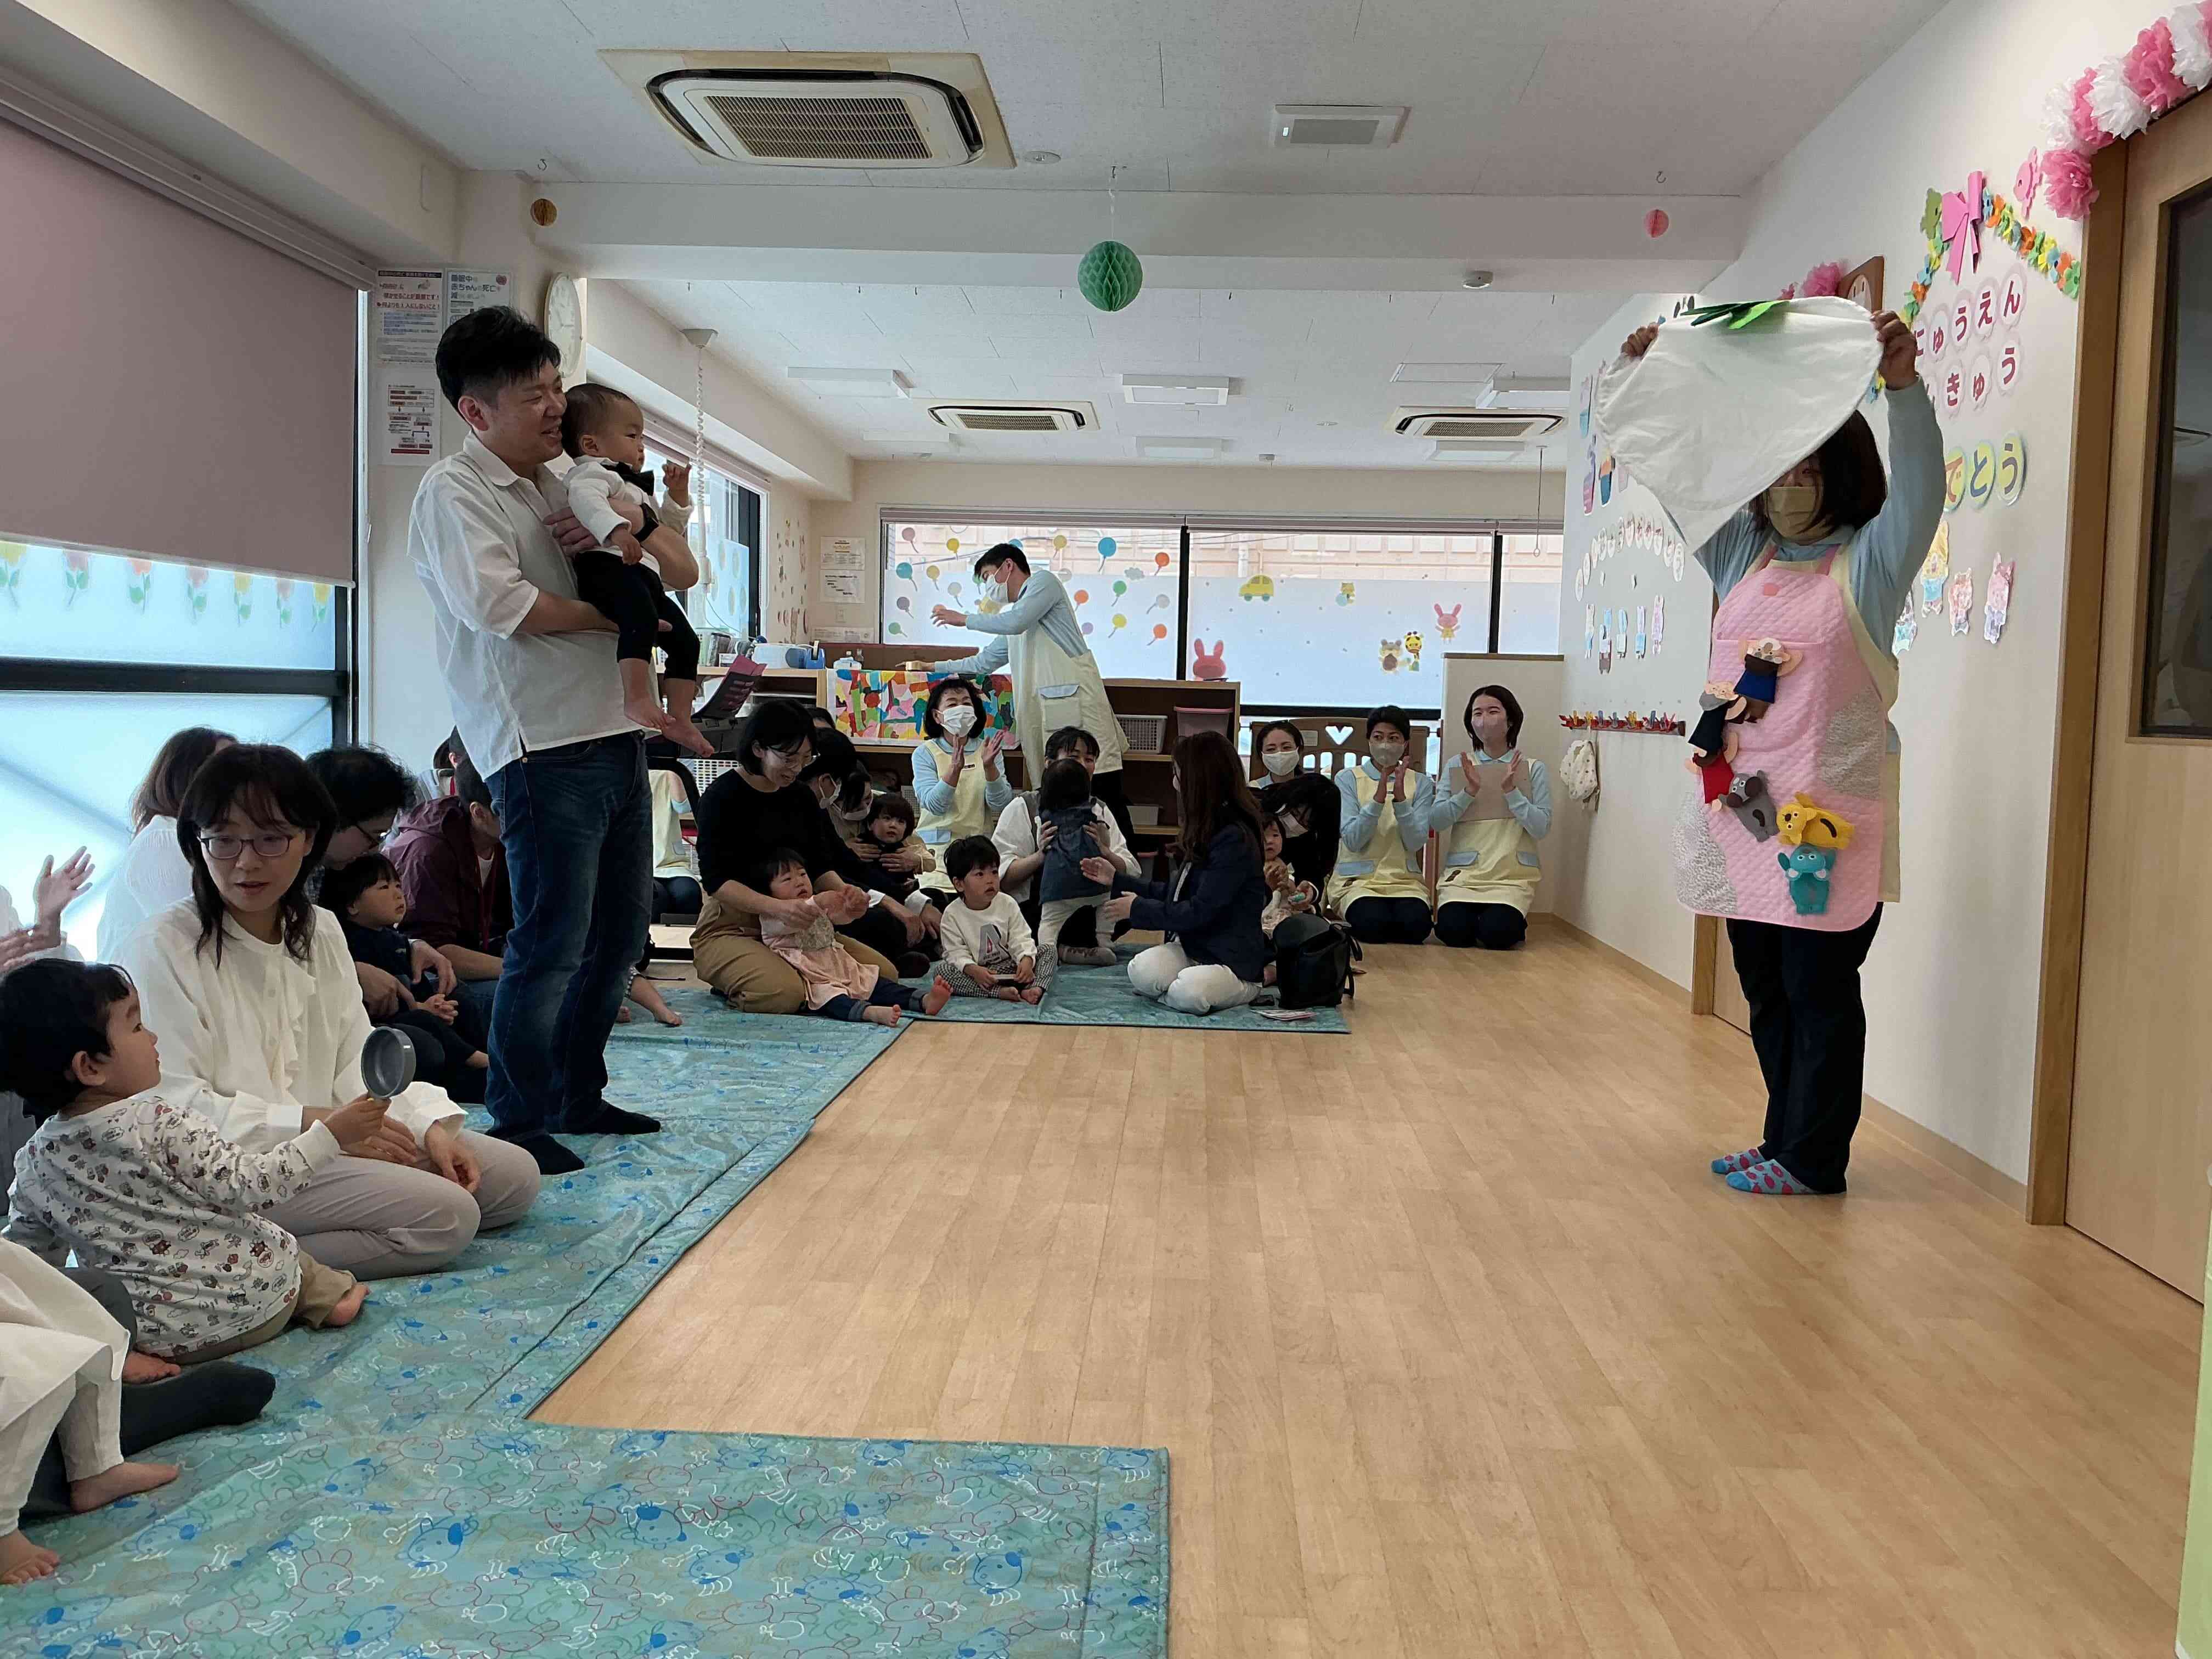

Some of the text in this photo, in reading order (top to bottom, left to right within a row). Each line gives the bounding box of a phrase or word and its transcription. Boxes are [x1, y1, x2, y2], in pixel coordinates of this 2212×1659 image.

[1926, 347, 2015, 407] きゅう
[1945, 443, 2017, 502] でとう
